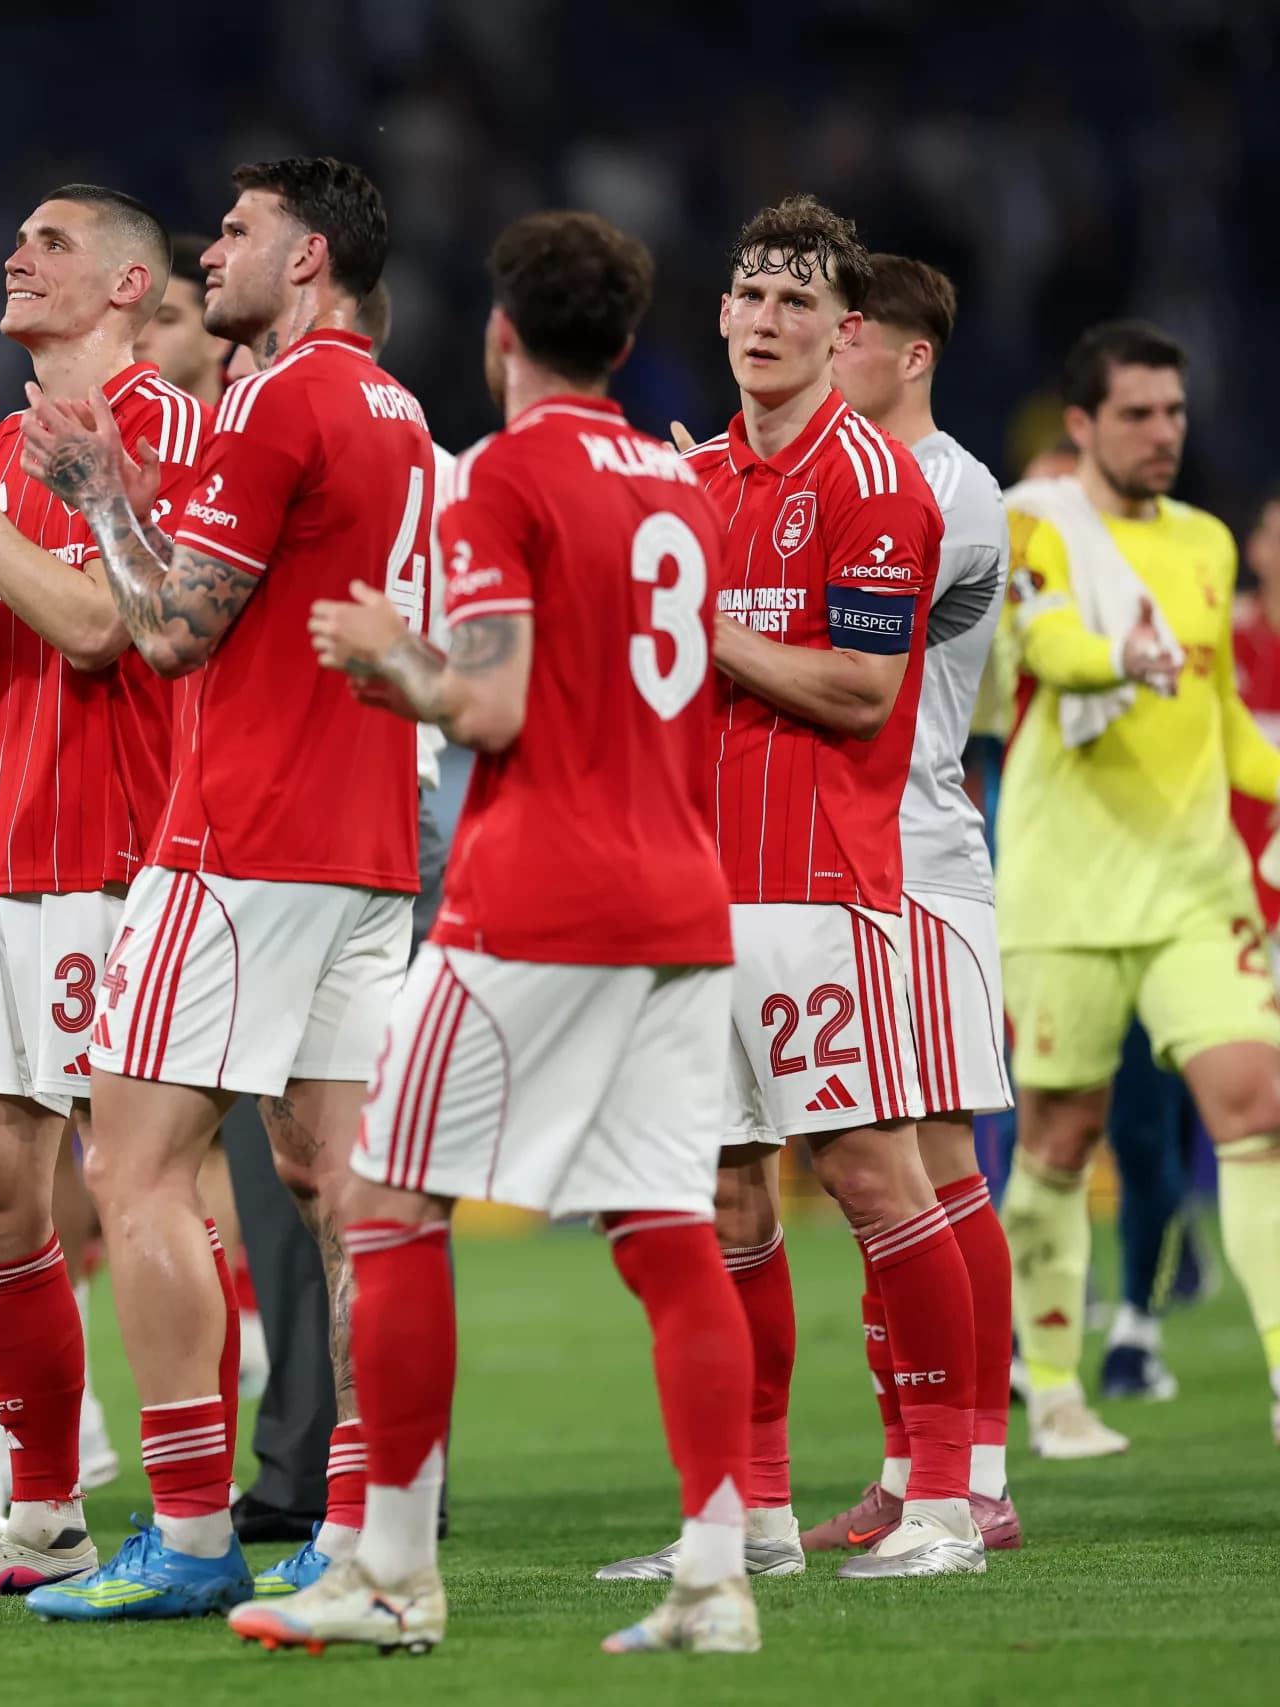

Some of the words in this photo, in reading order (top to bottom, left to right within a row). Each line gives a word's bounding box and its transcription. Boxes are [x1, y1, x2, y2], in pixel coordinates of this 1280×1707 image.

[185, 499, 238, 529] deagen
[385, 466, 426, 634] 4
[629, 511, 709, 721] 3
[748, 611, 790, 632] TRUST
[753, 588, 807, 610] FOREST
[843, 611, 903, 632] RESPECT
[52, 953, 108, 1034] 3
[761, 983, 862, 1078] 22
